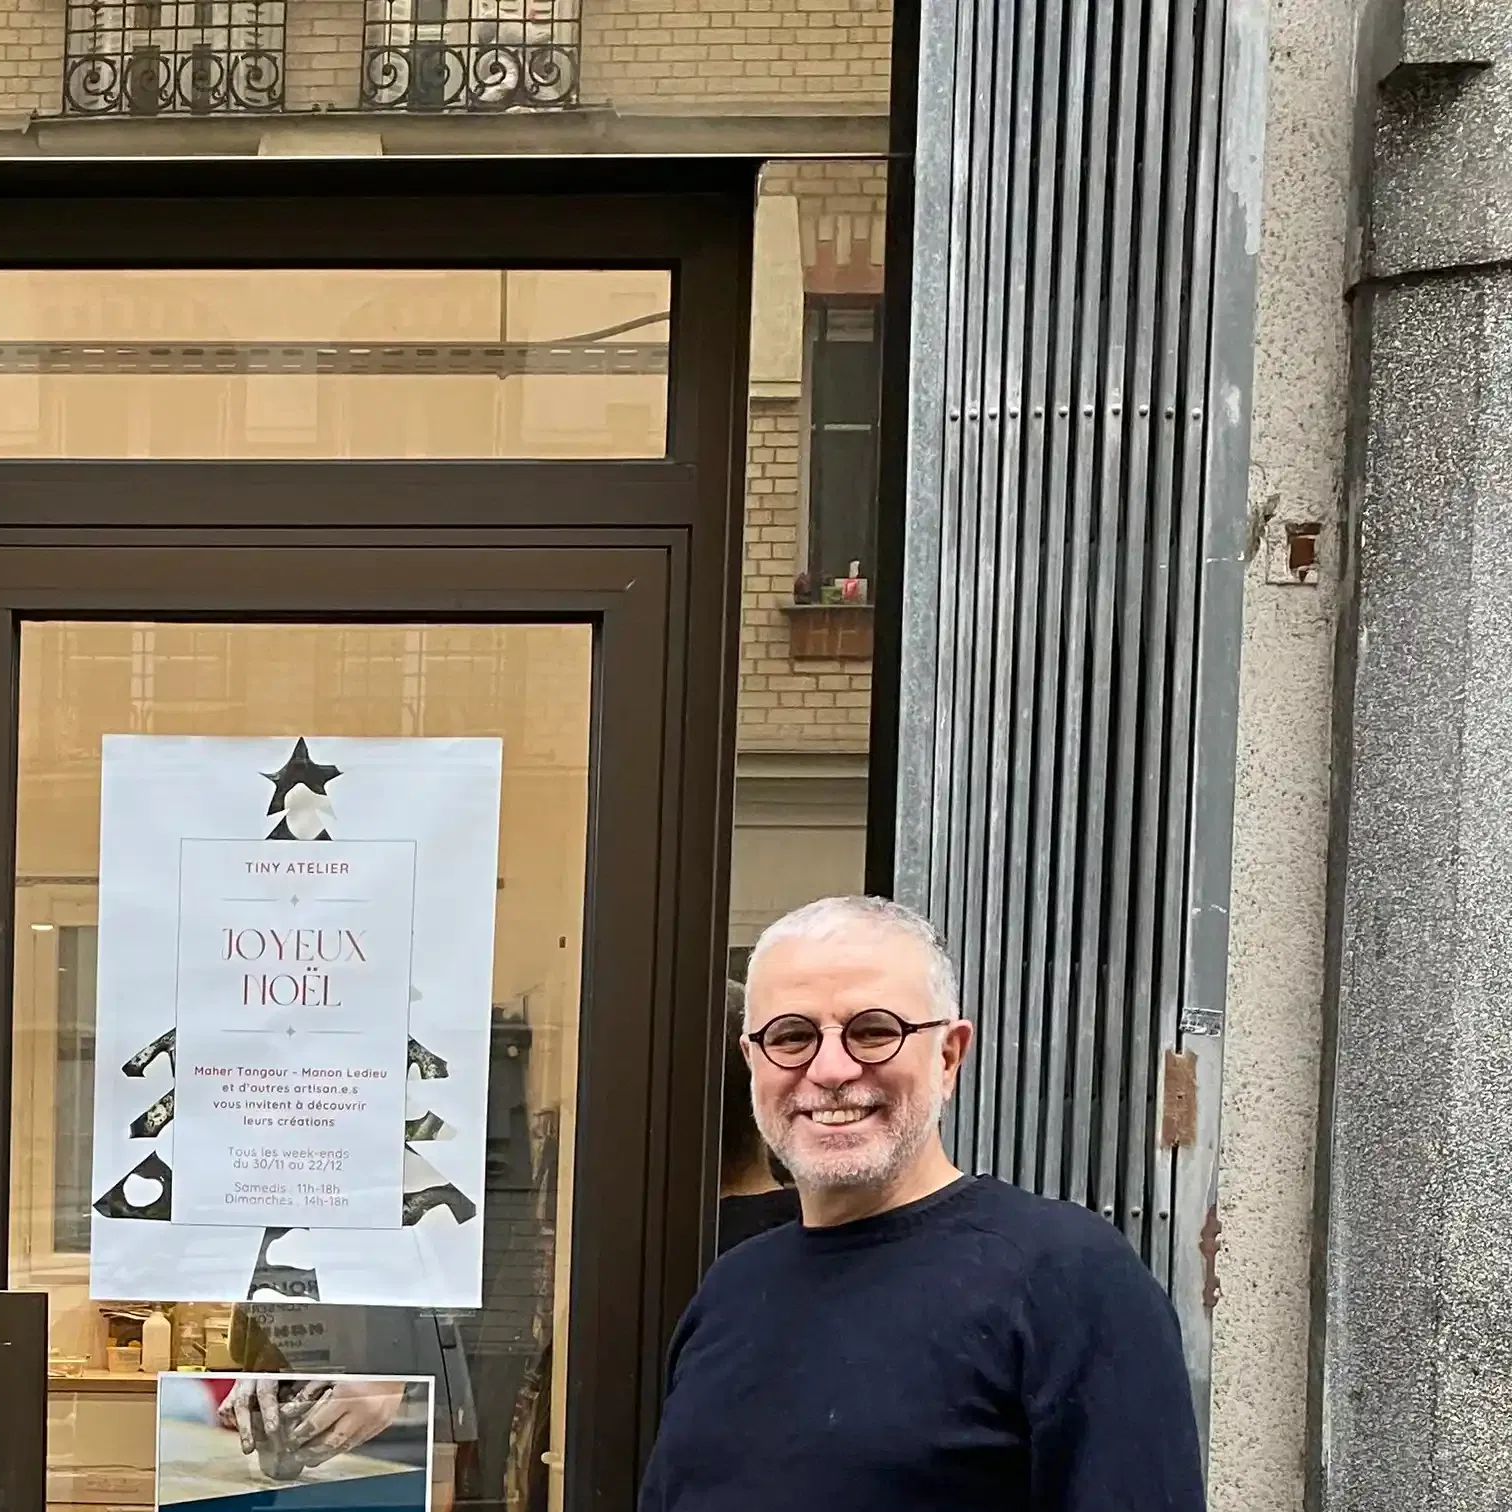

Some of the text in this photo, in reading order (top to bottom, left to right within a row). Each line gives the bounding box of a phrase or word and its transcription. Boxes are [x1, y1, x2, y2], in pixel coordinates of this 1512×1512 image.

[245, 862, 349, 874] TINY ATELIER
[221, 928, 367, 962] JOYEUX
[243, 966, 341, 1006] NOËL
[194, 1066, 233, 1077] Maher
[238, 1066, 288, 1079] Tangour
[301, 1067, 343, 1078] Manon
[346, 1068, 388, 1079] Ledieu
[222, 1083, 359, 1095] et d'autres artisan.e.s
[213, 1100, 367, 1112] vous invitent à découvrir
[243, 1116, 335, 1127] leurs créations
[228, 1147, 350, 1159] Tous les week-ends
[233, 1159, 249, 1169] du
[253, 1159, 284, 1170] 30/11
[288, 1161, 304, 1171] au
[234, 1182, 340, 1194] Samedis 11h-18h
[225, 1194, 349, 1206] Dimanches 14h-18h
